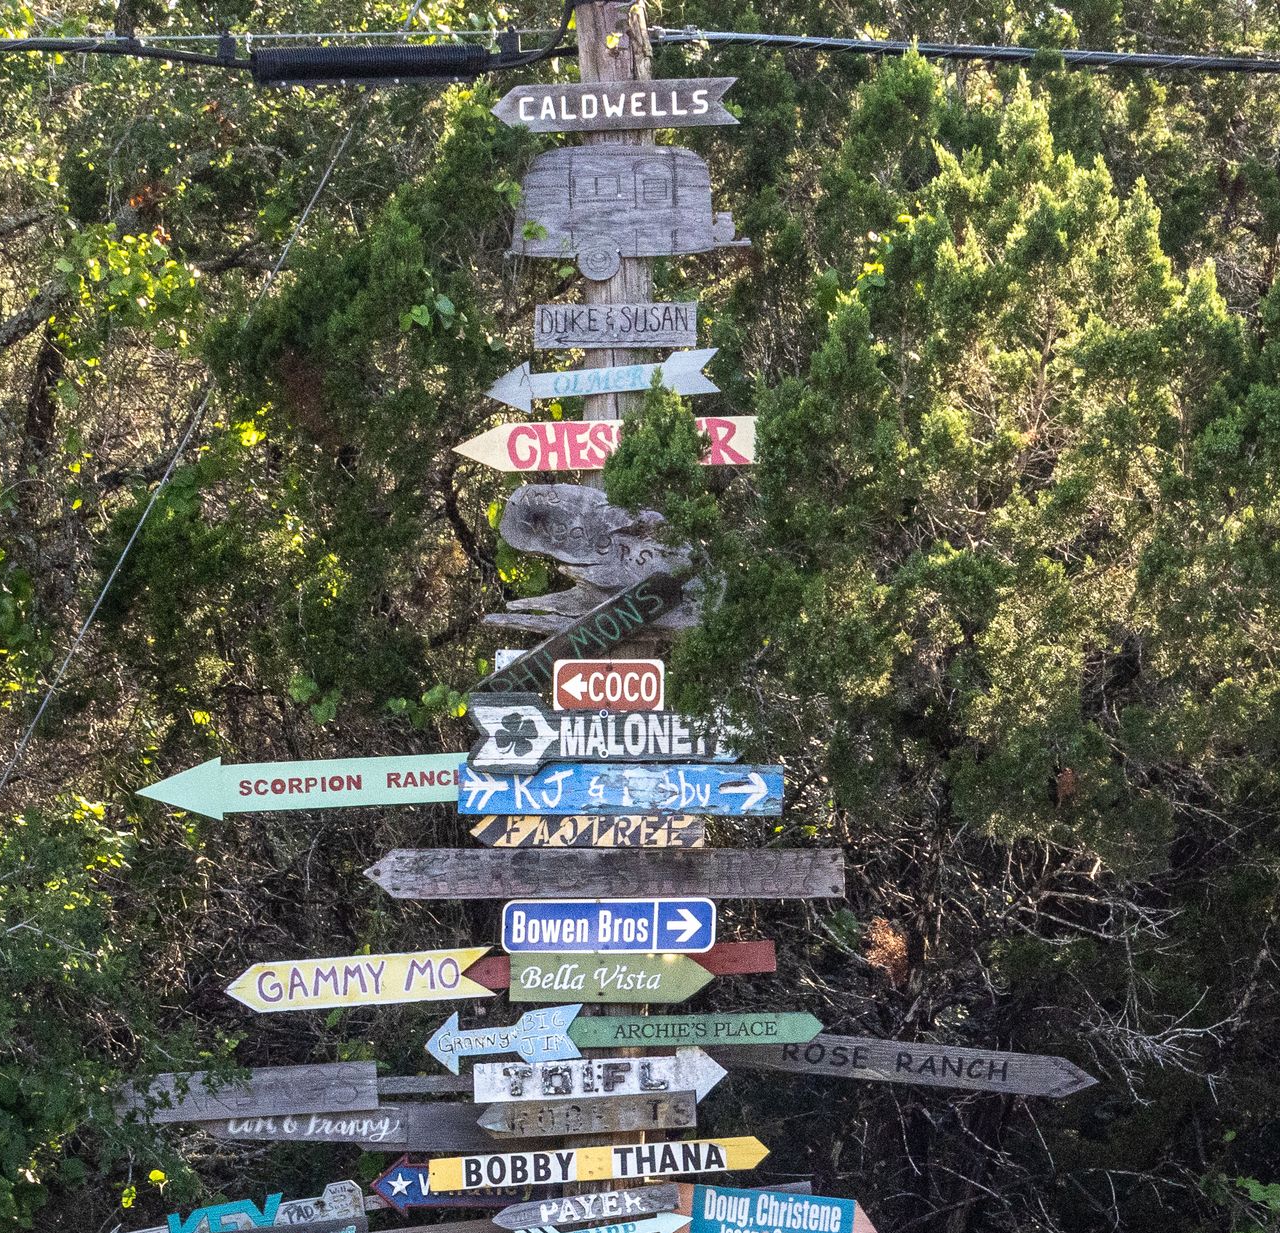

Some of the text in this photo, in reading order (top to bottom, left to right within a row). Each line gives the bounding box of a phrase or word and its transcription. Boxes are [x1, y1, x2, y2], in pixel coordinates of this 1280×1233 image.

[518, 89, 709, 121] CALDWELLS
[540, 307, 689, 334] DUKE SUSAN
[588, 672, 657, 702] COCO
[239, 775, 361, 796] SCORPION
[512, 912, 650, 943] Bowen Bros
[257, 960, 383, 1002] GAMMY
[521, 963, 661, 990] Bella Vista
[614, 1022, 778, 1039] ARCHIE'S PLACE
[897, 1053, 1008, 1082] RANCH
[465, 1144, 725, 1184] BOBBY THANA
